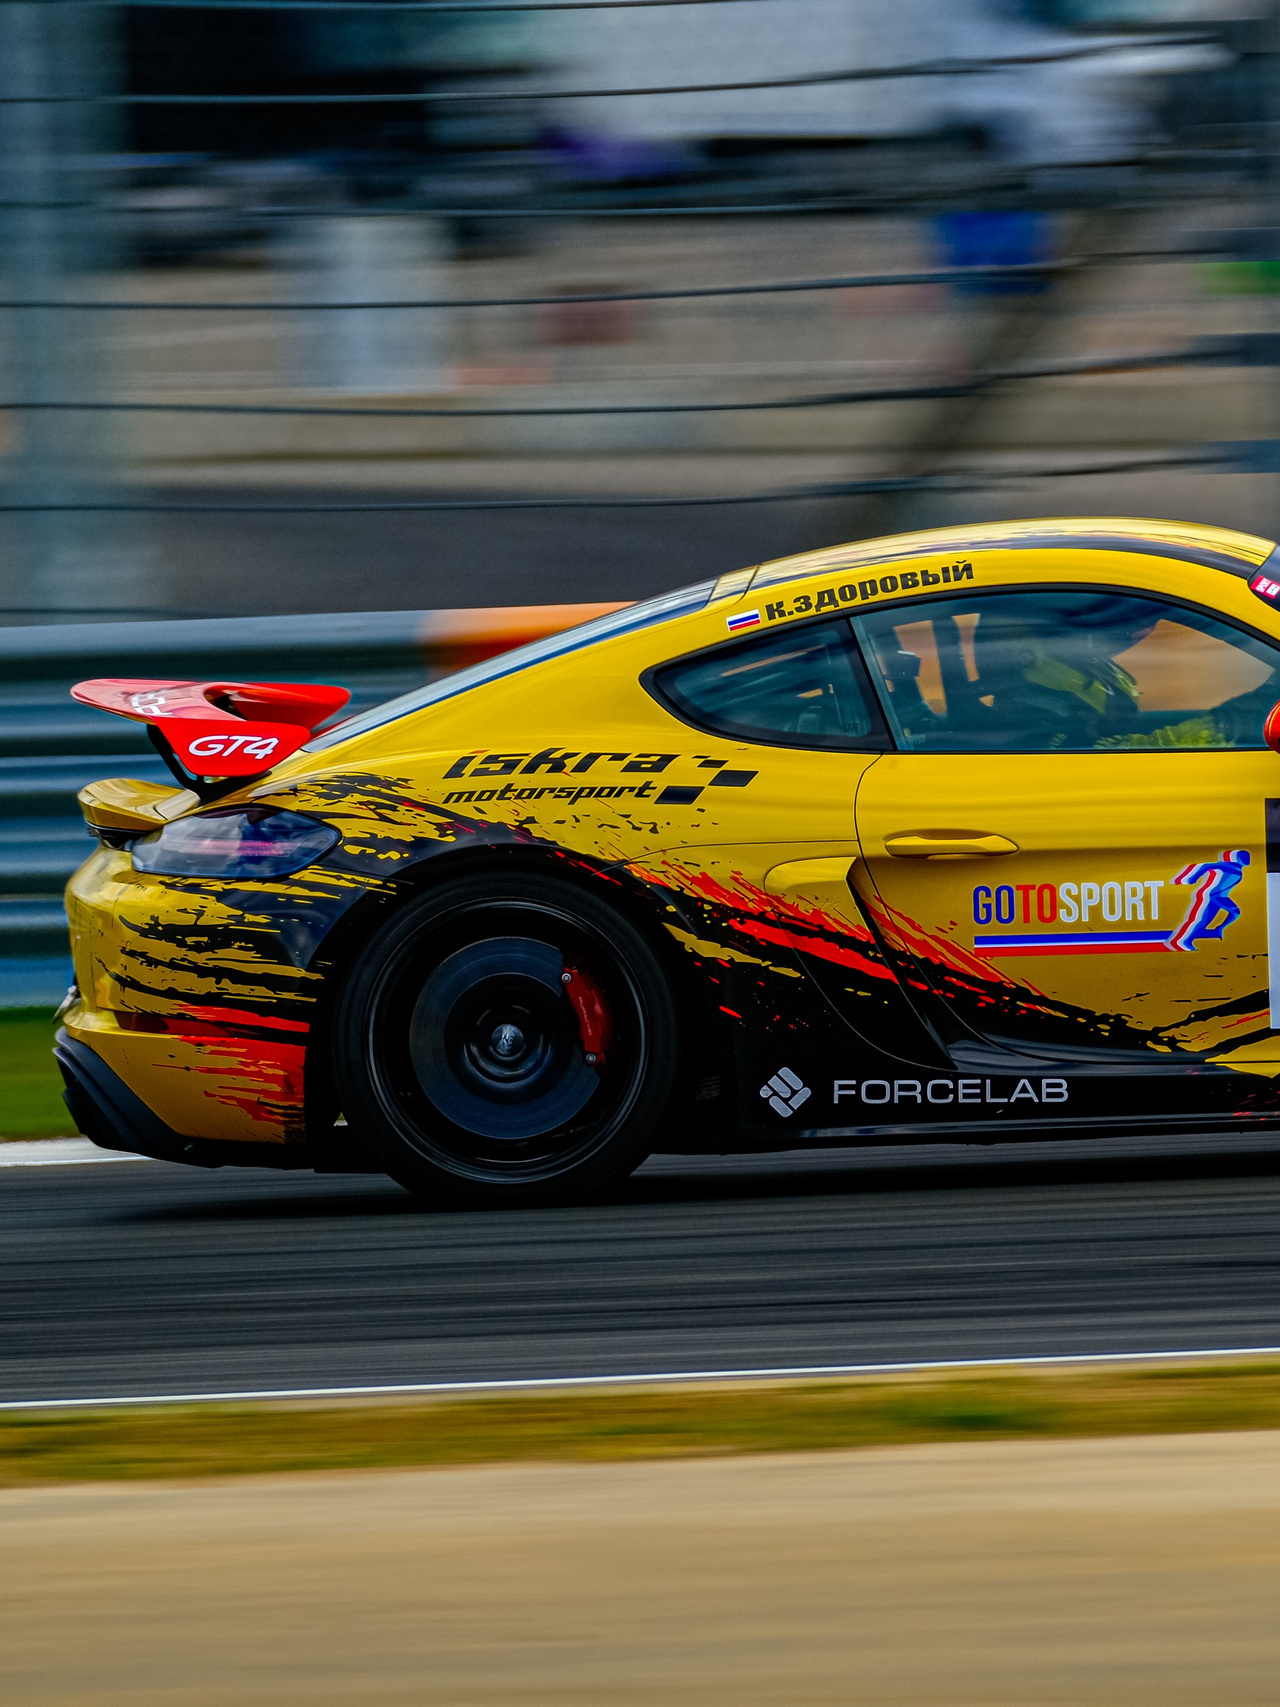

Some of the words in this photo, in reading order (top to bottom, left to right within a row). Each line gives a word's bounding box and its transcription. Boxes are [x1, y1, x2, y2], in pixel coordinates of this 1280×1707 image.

[188, 734, 280, 760] GT4
[442, 747, 681, 779] iskra
[442, 781, 657, 805] motorsport
[972, 880, 1165, 925] GOTOSPORT
[833, 1078, 1069, 1104] FORCELAB
